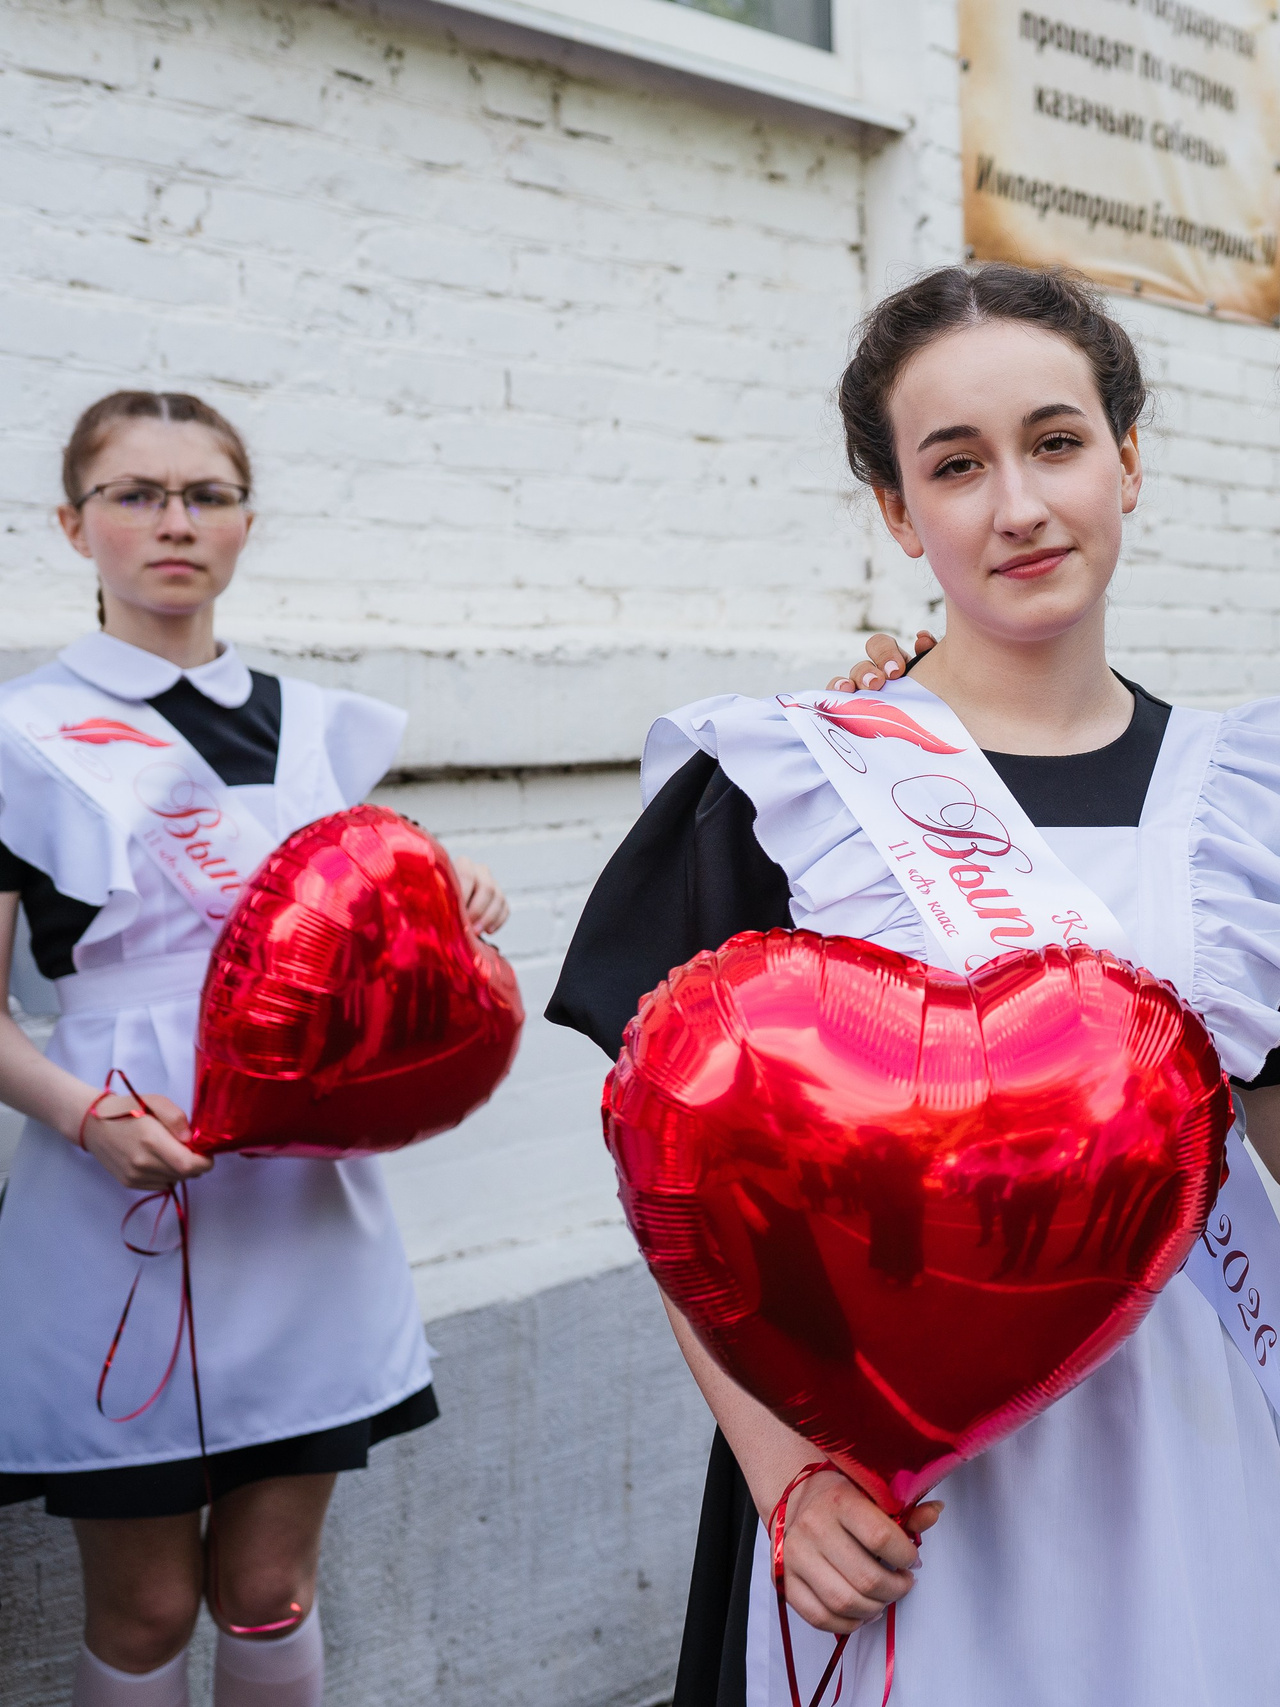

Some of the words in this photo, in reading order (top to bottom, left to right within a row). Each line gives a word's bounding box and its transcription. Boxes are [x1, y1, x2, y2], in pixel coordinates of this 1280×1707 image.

[1019, 10, 1135, 68] проходят
[1140, 51, 1163, 82] по
[1033, 84, 1145, 143] казачьих
[975, 152, 1146, 238] Императрица
[888, 839, 917, 863] 11
[907, 868, 936, 896] «А»
[928, 901, 959, 938] класс
[891, 774, 1034, 971] Вып
[1201, 1214, 1277, 1366] 2026
